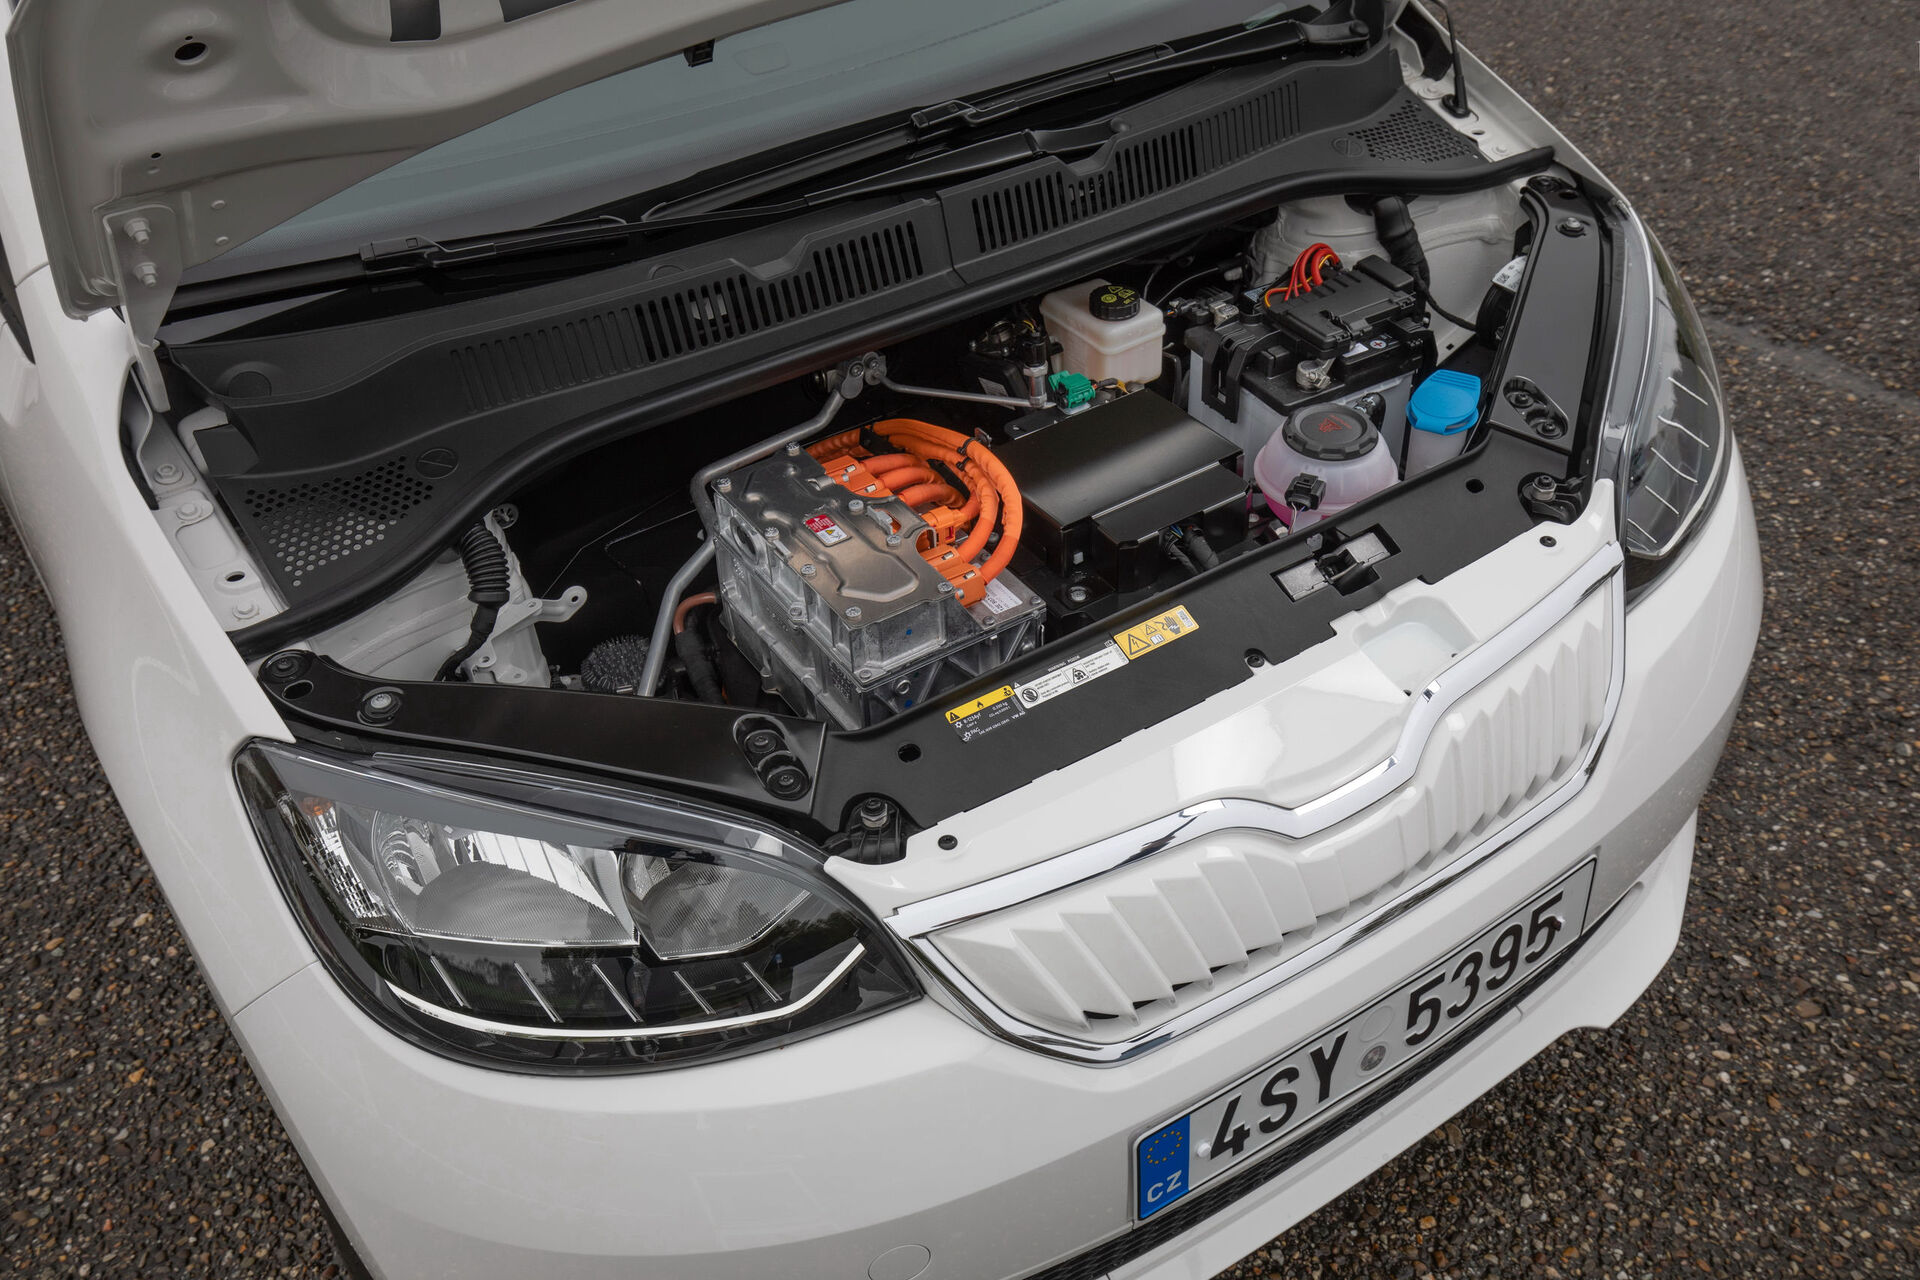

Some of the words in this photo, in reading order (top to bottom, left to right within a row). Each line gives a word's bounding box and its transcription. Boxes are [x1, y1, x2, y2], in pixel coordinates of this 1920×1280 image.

[1210, 1031, 1349, 1160] 4SY
[1405, 891, 1564, 1046] 5395
[1147, 1169, 1182, 1203] CZ
